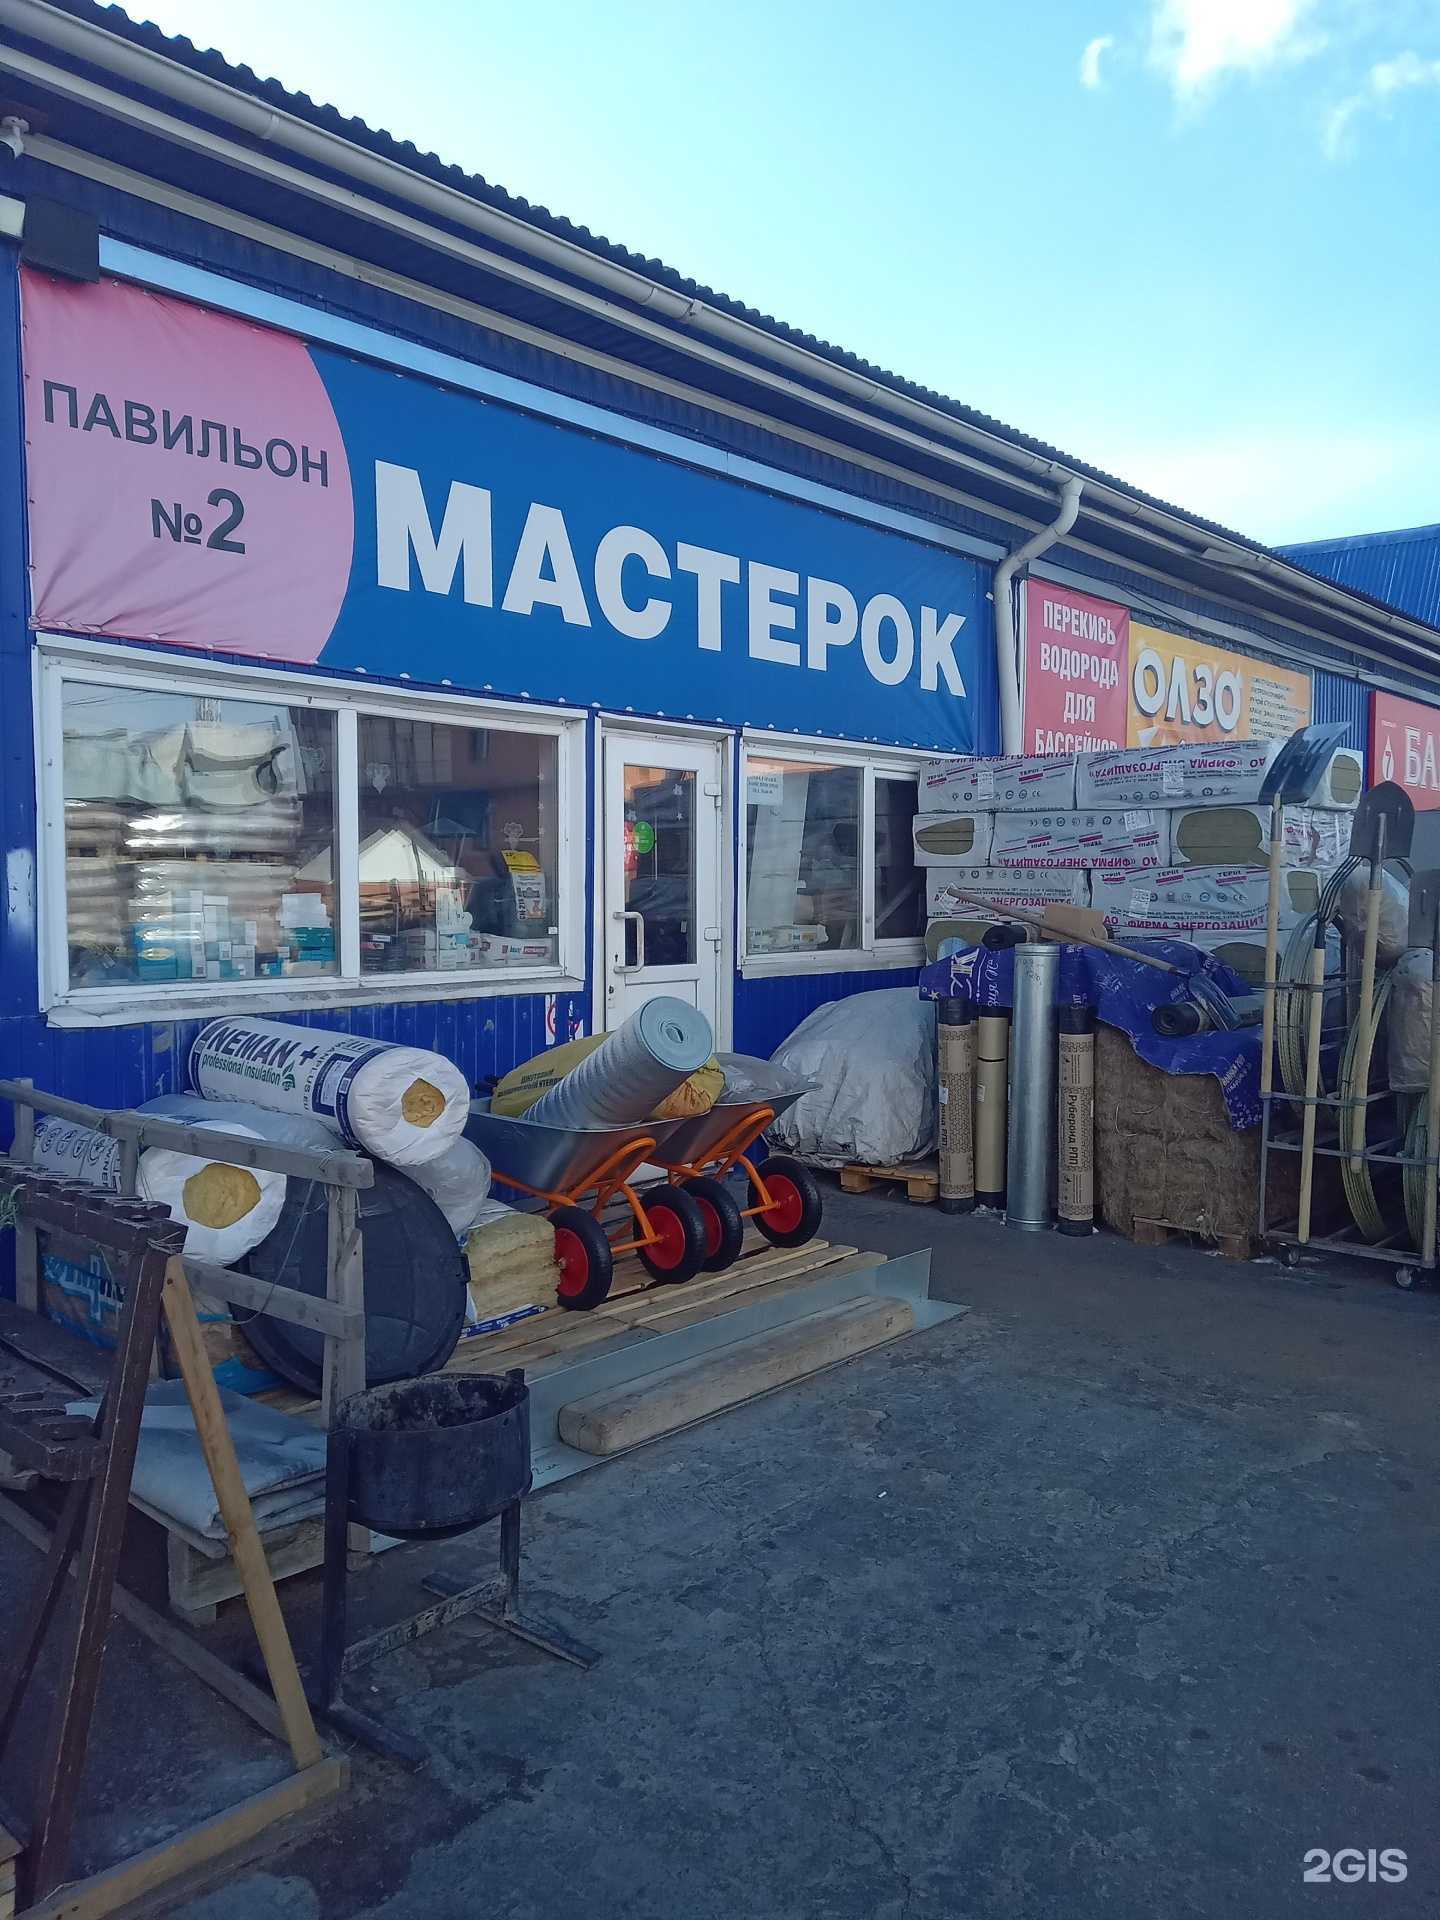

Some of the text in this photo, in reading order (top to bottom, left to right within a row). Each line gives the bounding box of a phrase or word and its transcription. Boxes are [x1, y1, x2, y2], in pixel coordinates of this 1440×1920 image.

[43, 379, 329, 488] ПАВИЛЬОН
[151, 488, 246, 555] №2
[374, 459, 967, 698] МАСТЕРОК
[1043, 599, 1117, 646] ПЕРЕКИСЬ
[1040, 642, 1119, 690] ВОДОРОДА
[1063, 691, 1096, 724] ДЛЯ
[1035, 728, 1118, 754] БАССЕЙН
[1403, 725, 1440, 791] БА
[201, 1053, 281, 1086] professional insulation
[206, 1026, 302, 1069] NEMAN
[1067, 1093, 1079, 1165] Рубероид РПП
